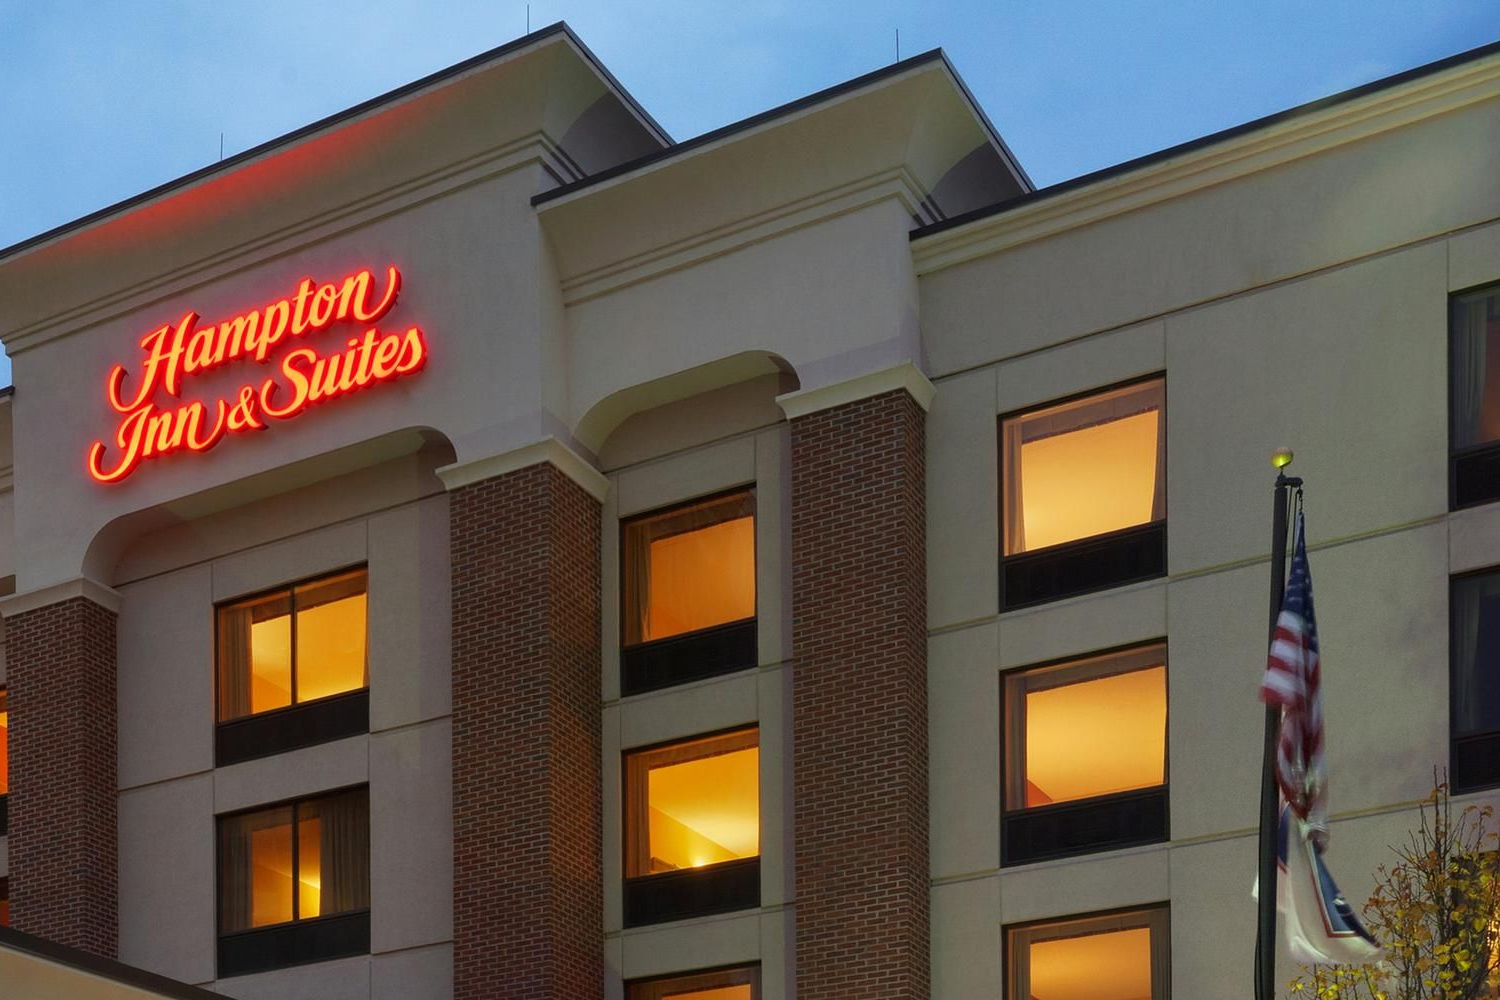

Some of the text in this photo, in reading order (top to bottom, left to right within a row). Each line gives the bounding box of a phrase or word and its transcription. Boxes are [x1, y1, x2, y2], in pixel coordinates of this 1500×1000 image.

[88, 326, 427, 483] Inn & Suites
[109, 265, 402, 413] Hampton
